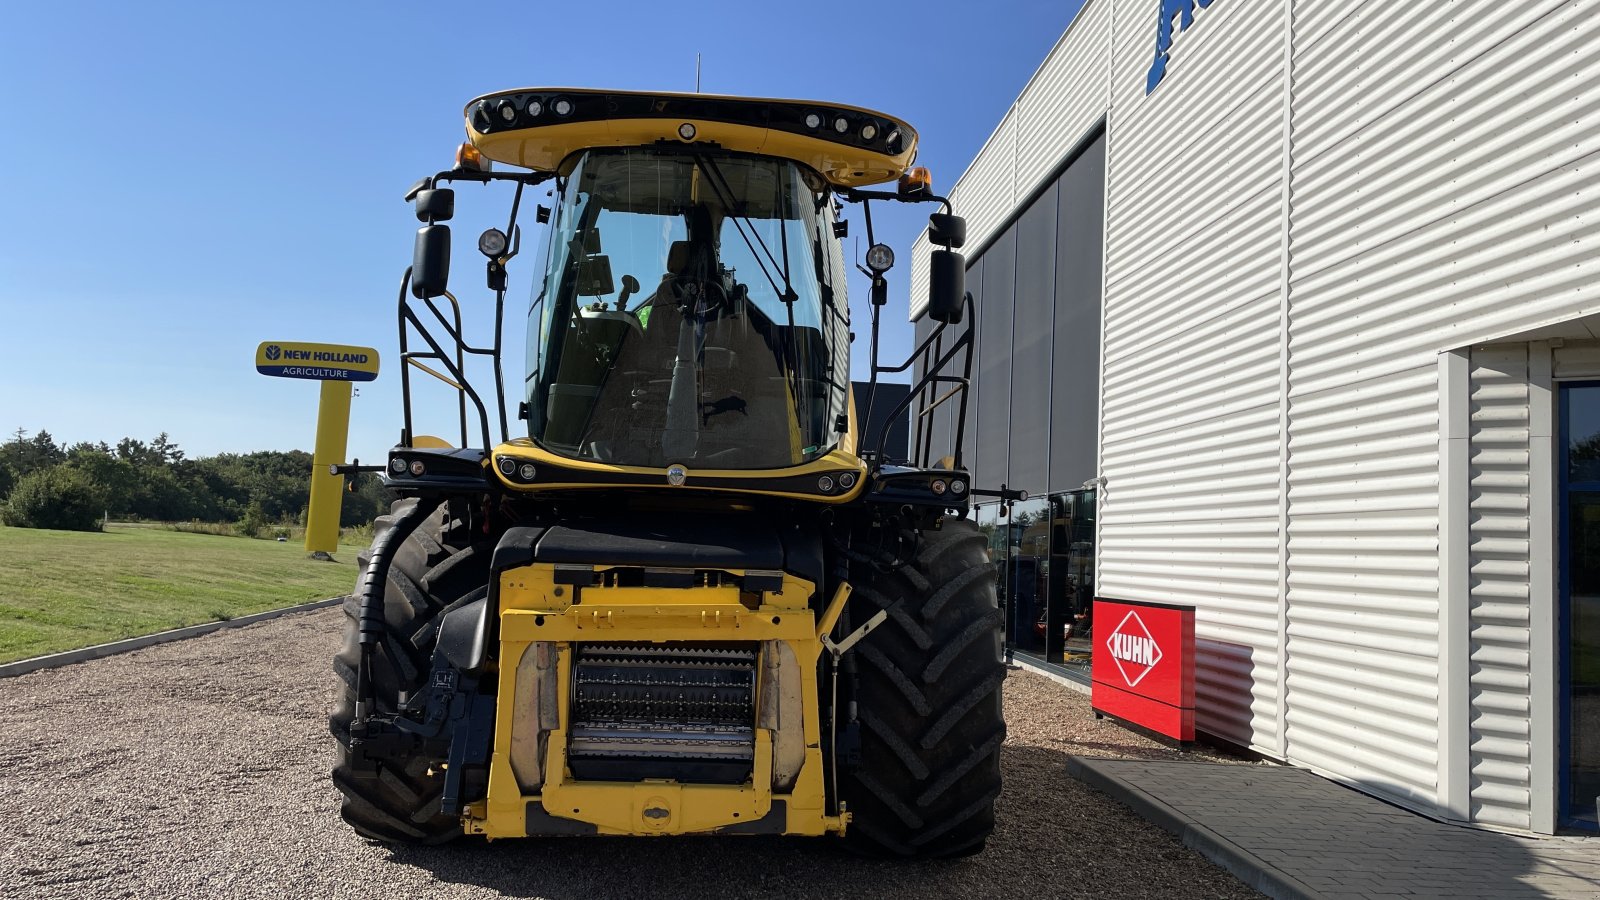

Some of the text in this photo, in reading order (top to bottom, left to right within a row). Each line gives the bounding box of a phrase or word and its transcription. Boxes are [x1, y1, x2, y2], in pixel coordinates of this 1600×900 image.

[284, 349, 368, 364] NEW HOLLAND
[282, 367, 348, 378] AGRICULTURE
[1113, 632, 1154, 667] KUHN
